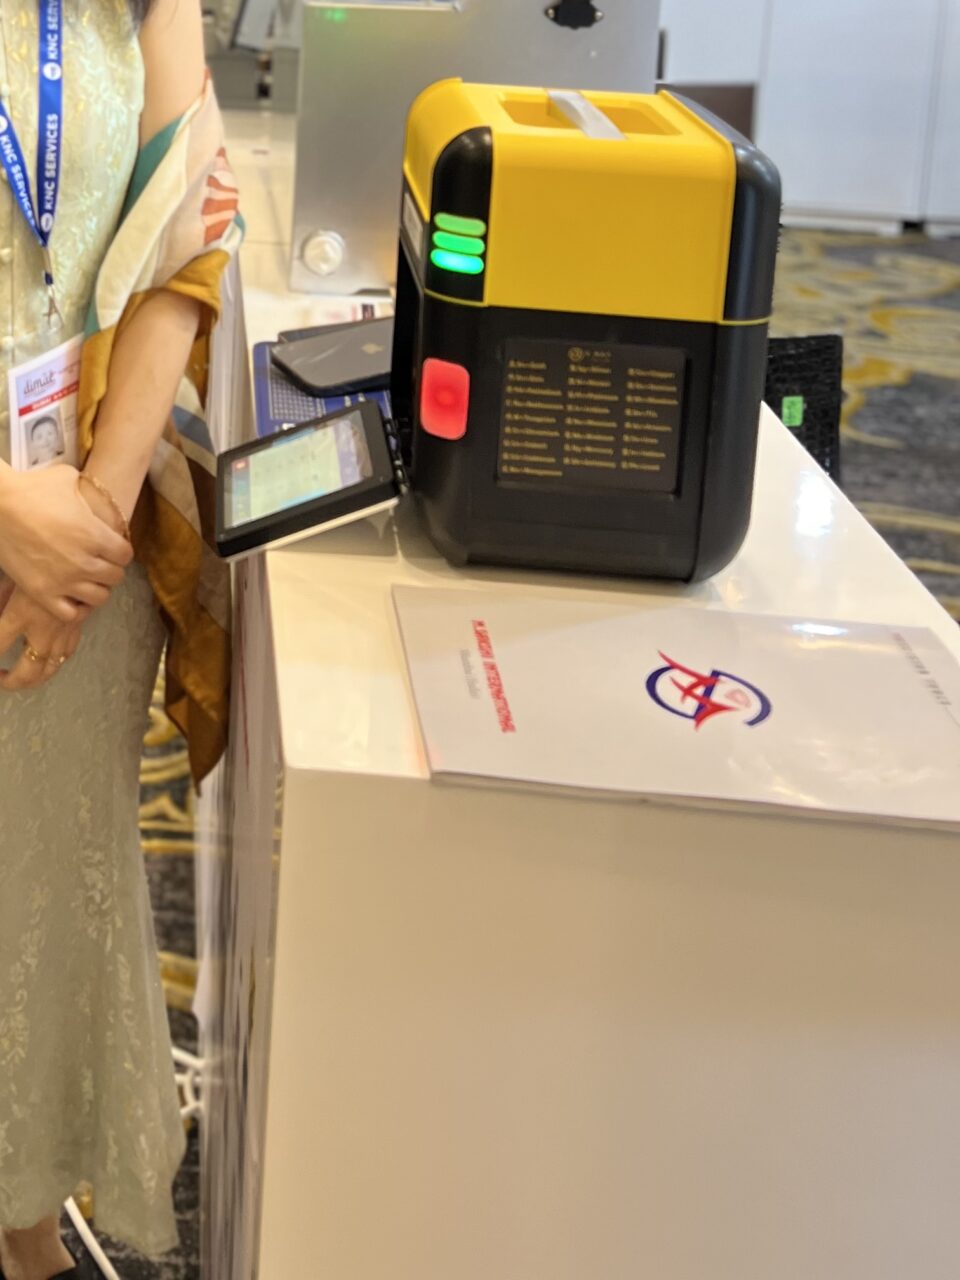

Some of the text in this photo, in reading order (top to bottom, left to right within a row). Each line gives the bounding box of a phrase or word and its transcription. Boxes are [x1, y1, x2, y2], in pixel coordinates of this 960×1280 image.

[46, 33, 59, 61] KNC
[0, 134, 18, 165] KNC
[44, 113, 59, 210] KNC SERVICES
